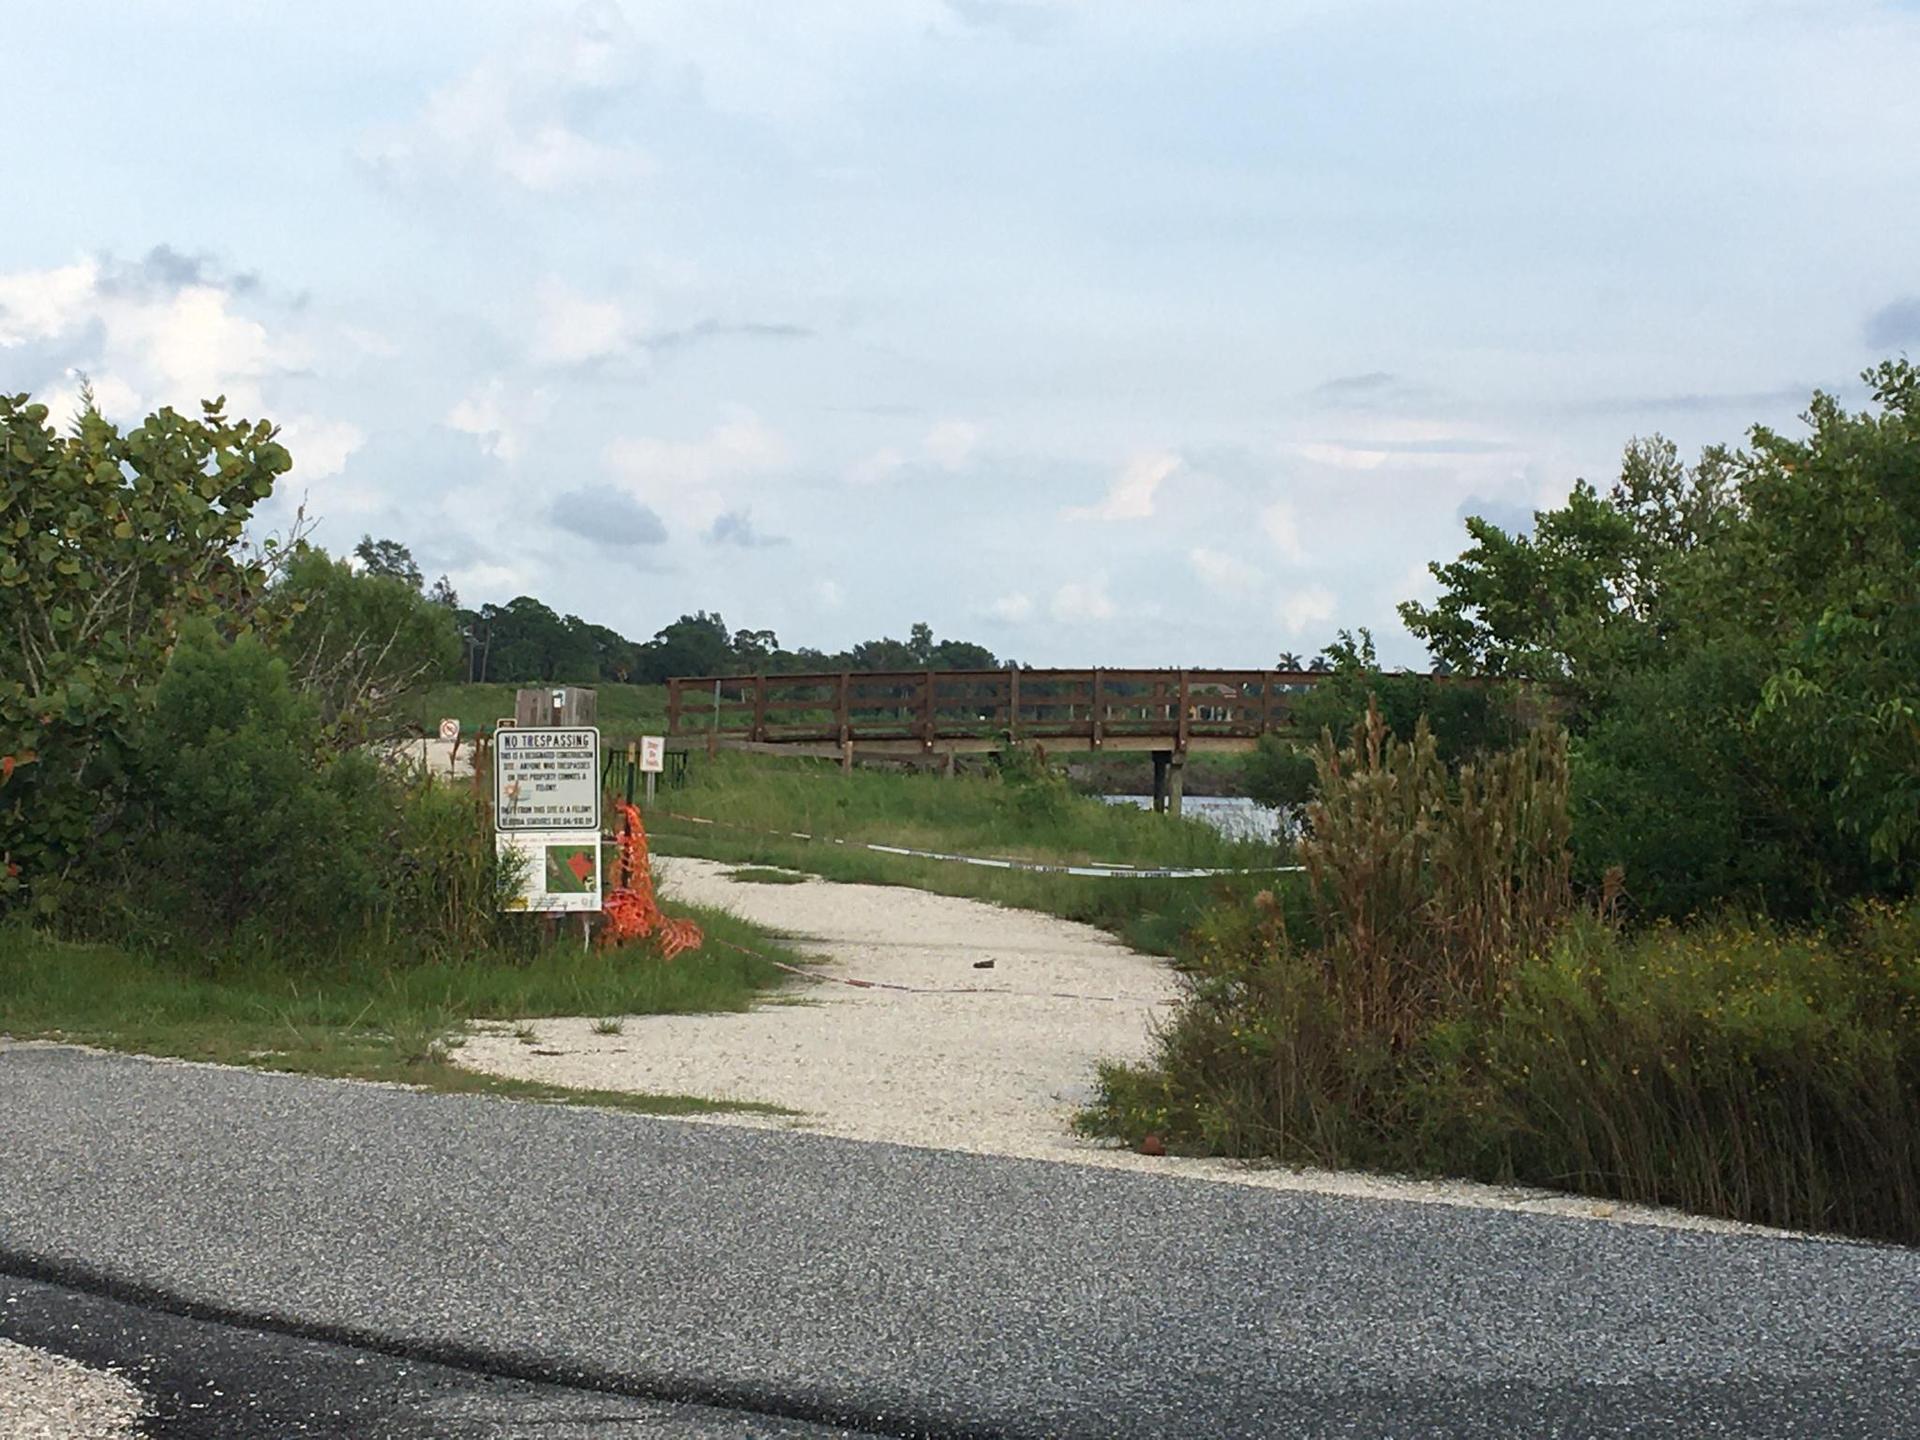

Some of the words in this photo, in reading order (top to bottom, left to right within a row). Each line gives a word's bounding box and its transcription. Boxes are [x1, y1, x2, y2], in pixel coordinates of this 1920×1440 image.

[504, 735, 518, 747] NO
[522, 734, 589, 747] TRESPASSING
[556, 751, 593, 759] CONSTRUCTION
